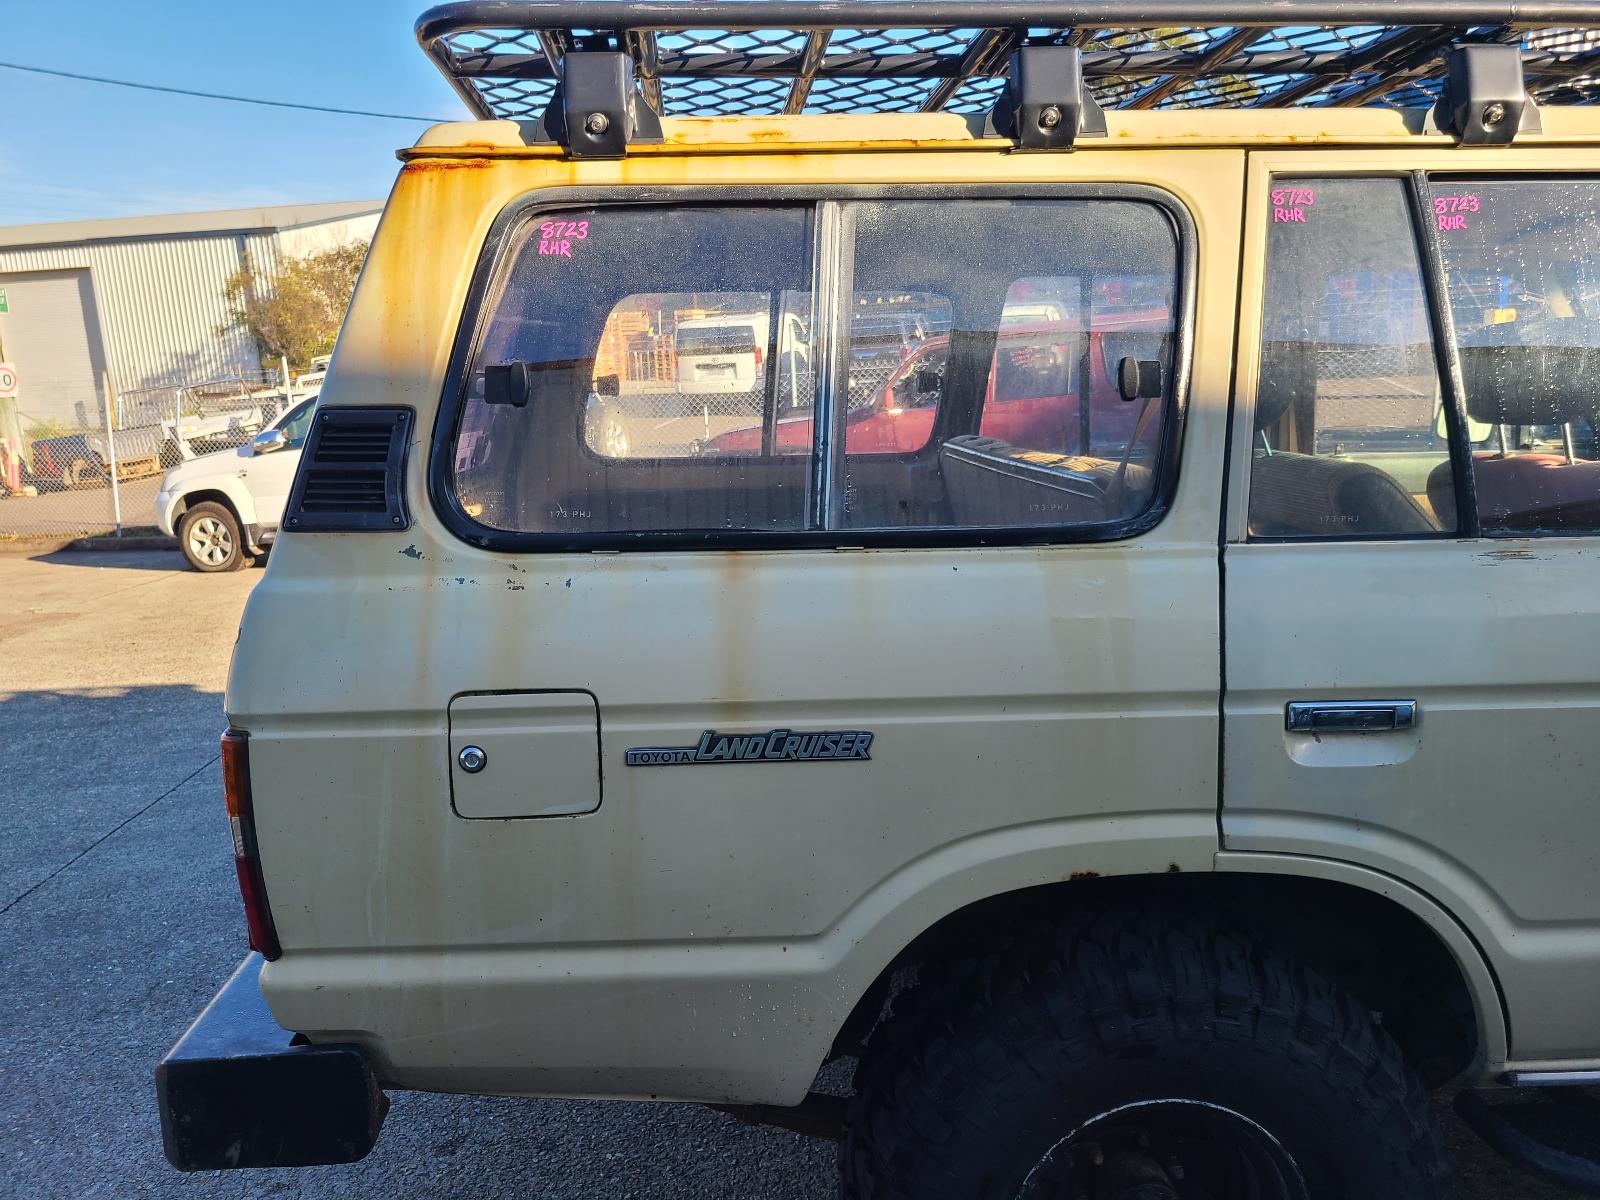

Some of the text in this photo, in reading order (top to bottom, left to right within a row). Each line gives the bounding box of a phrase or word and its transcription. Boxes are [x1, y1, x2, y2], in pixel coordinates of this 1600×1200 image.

[1271, 188, 1314, 206] 8723
[1434, 196, 1480, 214] 8723
[1273, 208, 1306, 223] RHR
[1438, 214, 1468, 230] RHR
[540, 221, 589, 240] 8723
[538, 239, 572, 258] RHR
[631, 751, 692, 763] TOYOTA
